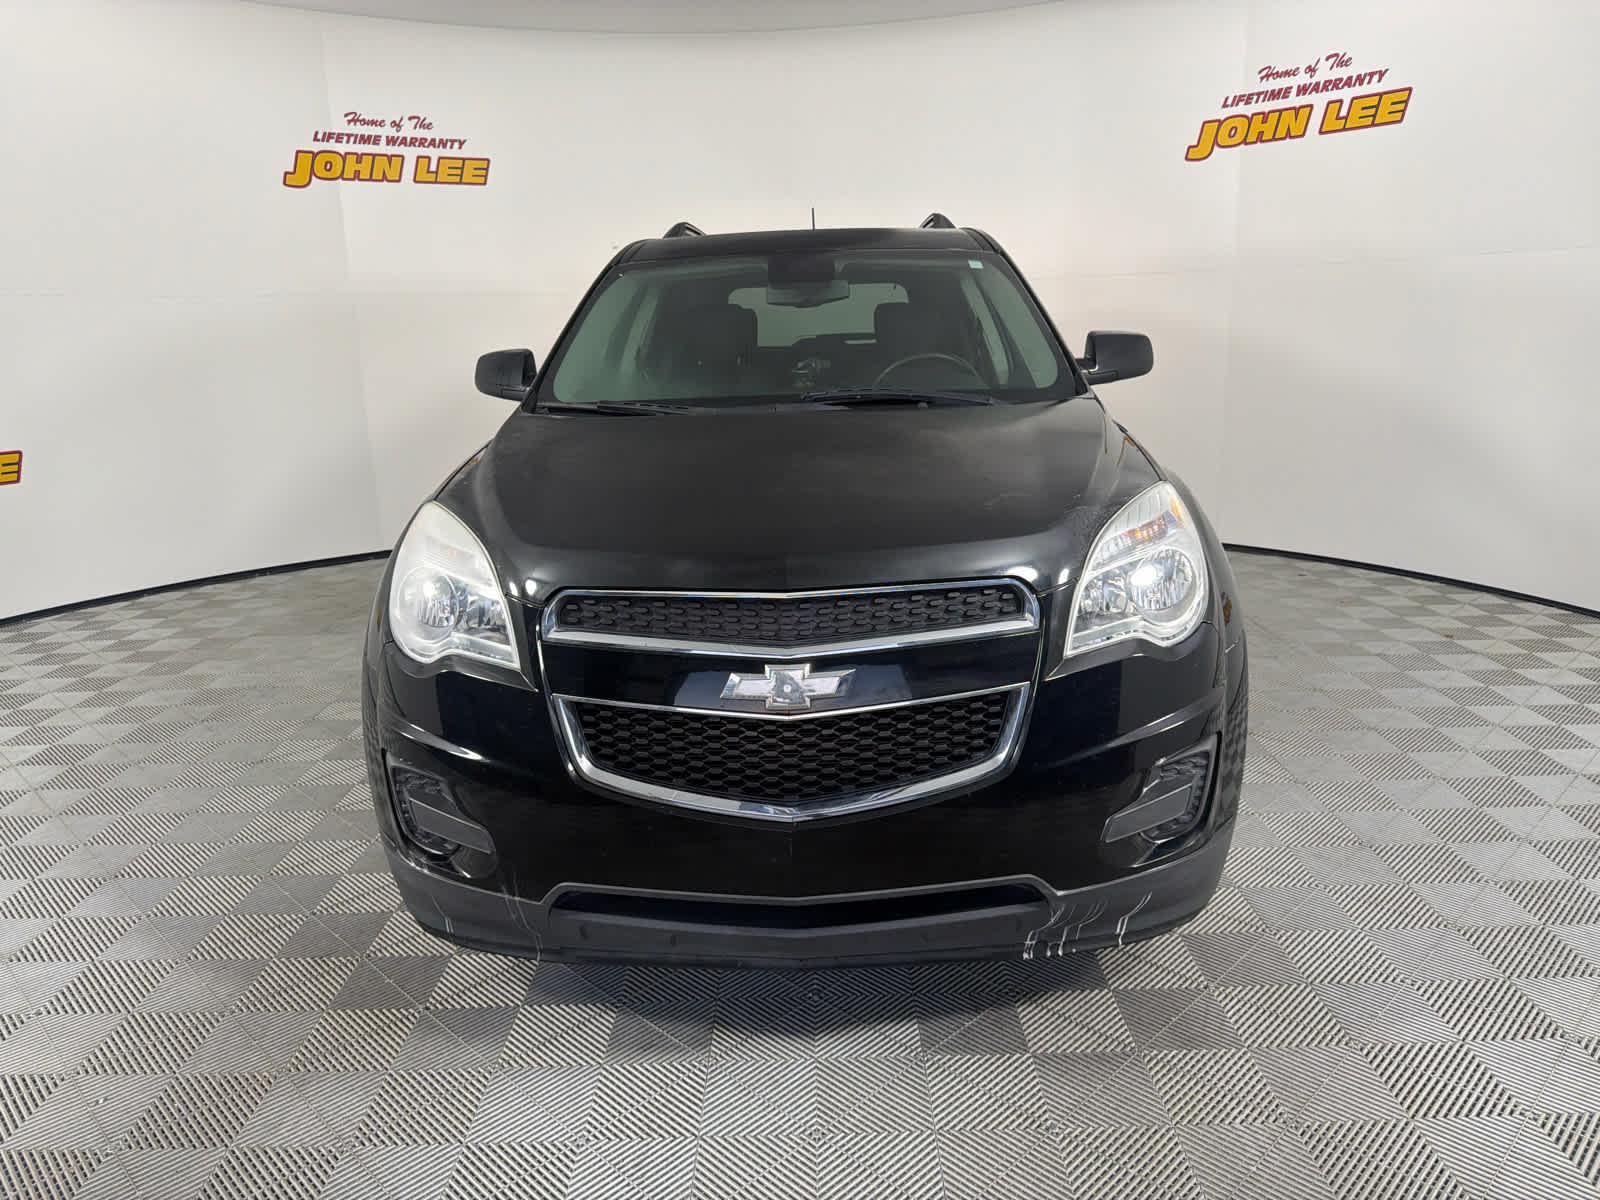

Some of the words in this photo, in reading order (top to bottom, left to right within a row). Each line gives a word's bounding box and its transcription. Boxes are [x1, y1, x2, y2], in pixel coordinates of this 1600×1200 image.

[1257, 65, 1300, 83] Home
[1304, 57, 1321, 78] of
[1325, 52, 1353, 71] The
[1221, 85, 1293, 109] LIFETIME
[1295, 68, 1389, 98] WARRANTY
[343, 111, 386, 128] Home
[390, 116, 404, 132] of
[407, 115, 434, 130] The
[1184, 104, 1314, 162] JOHN
[1318, 86, 1413, 136] LEE
[312, 130, 382, 146] LIFETIME
[385, 135, 467, 150] WARRANTY
[282, 149, 405, 189] JOHN
[412, 155, 491, 186] LEE
